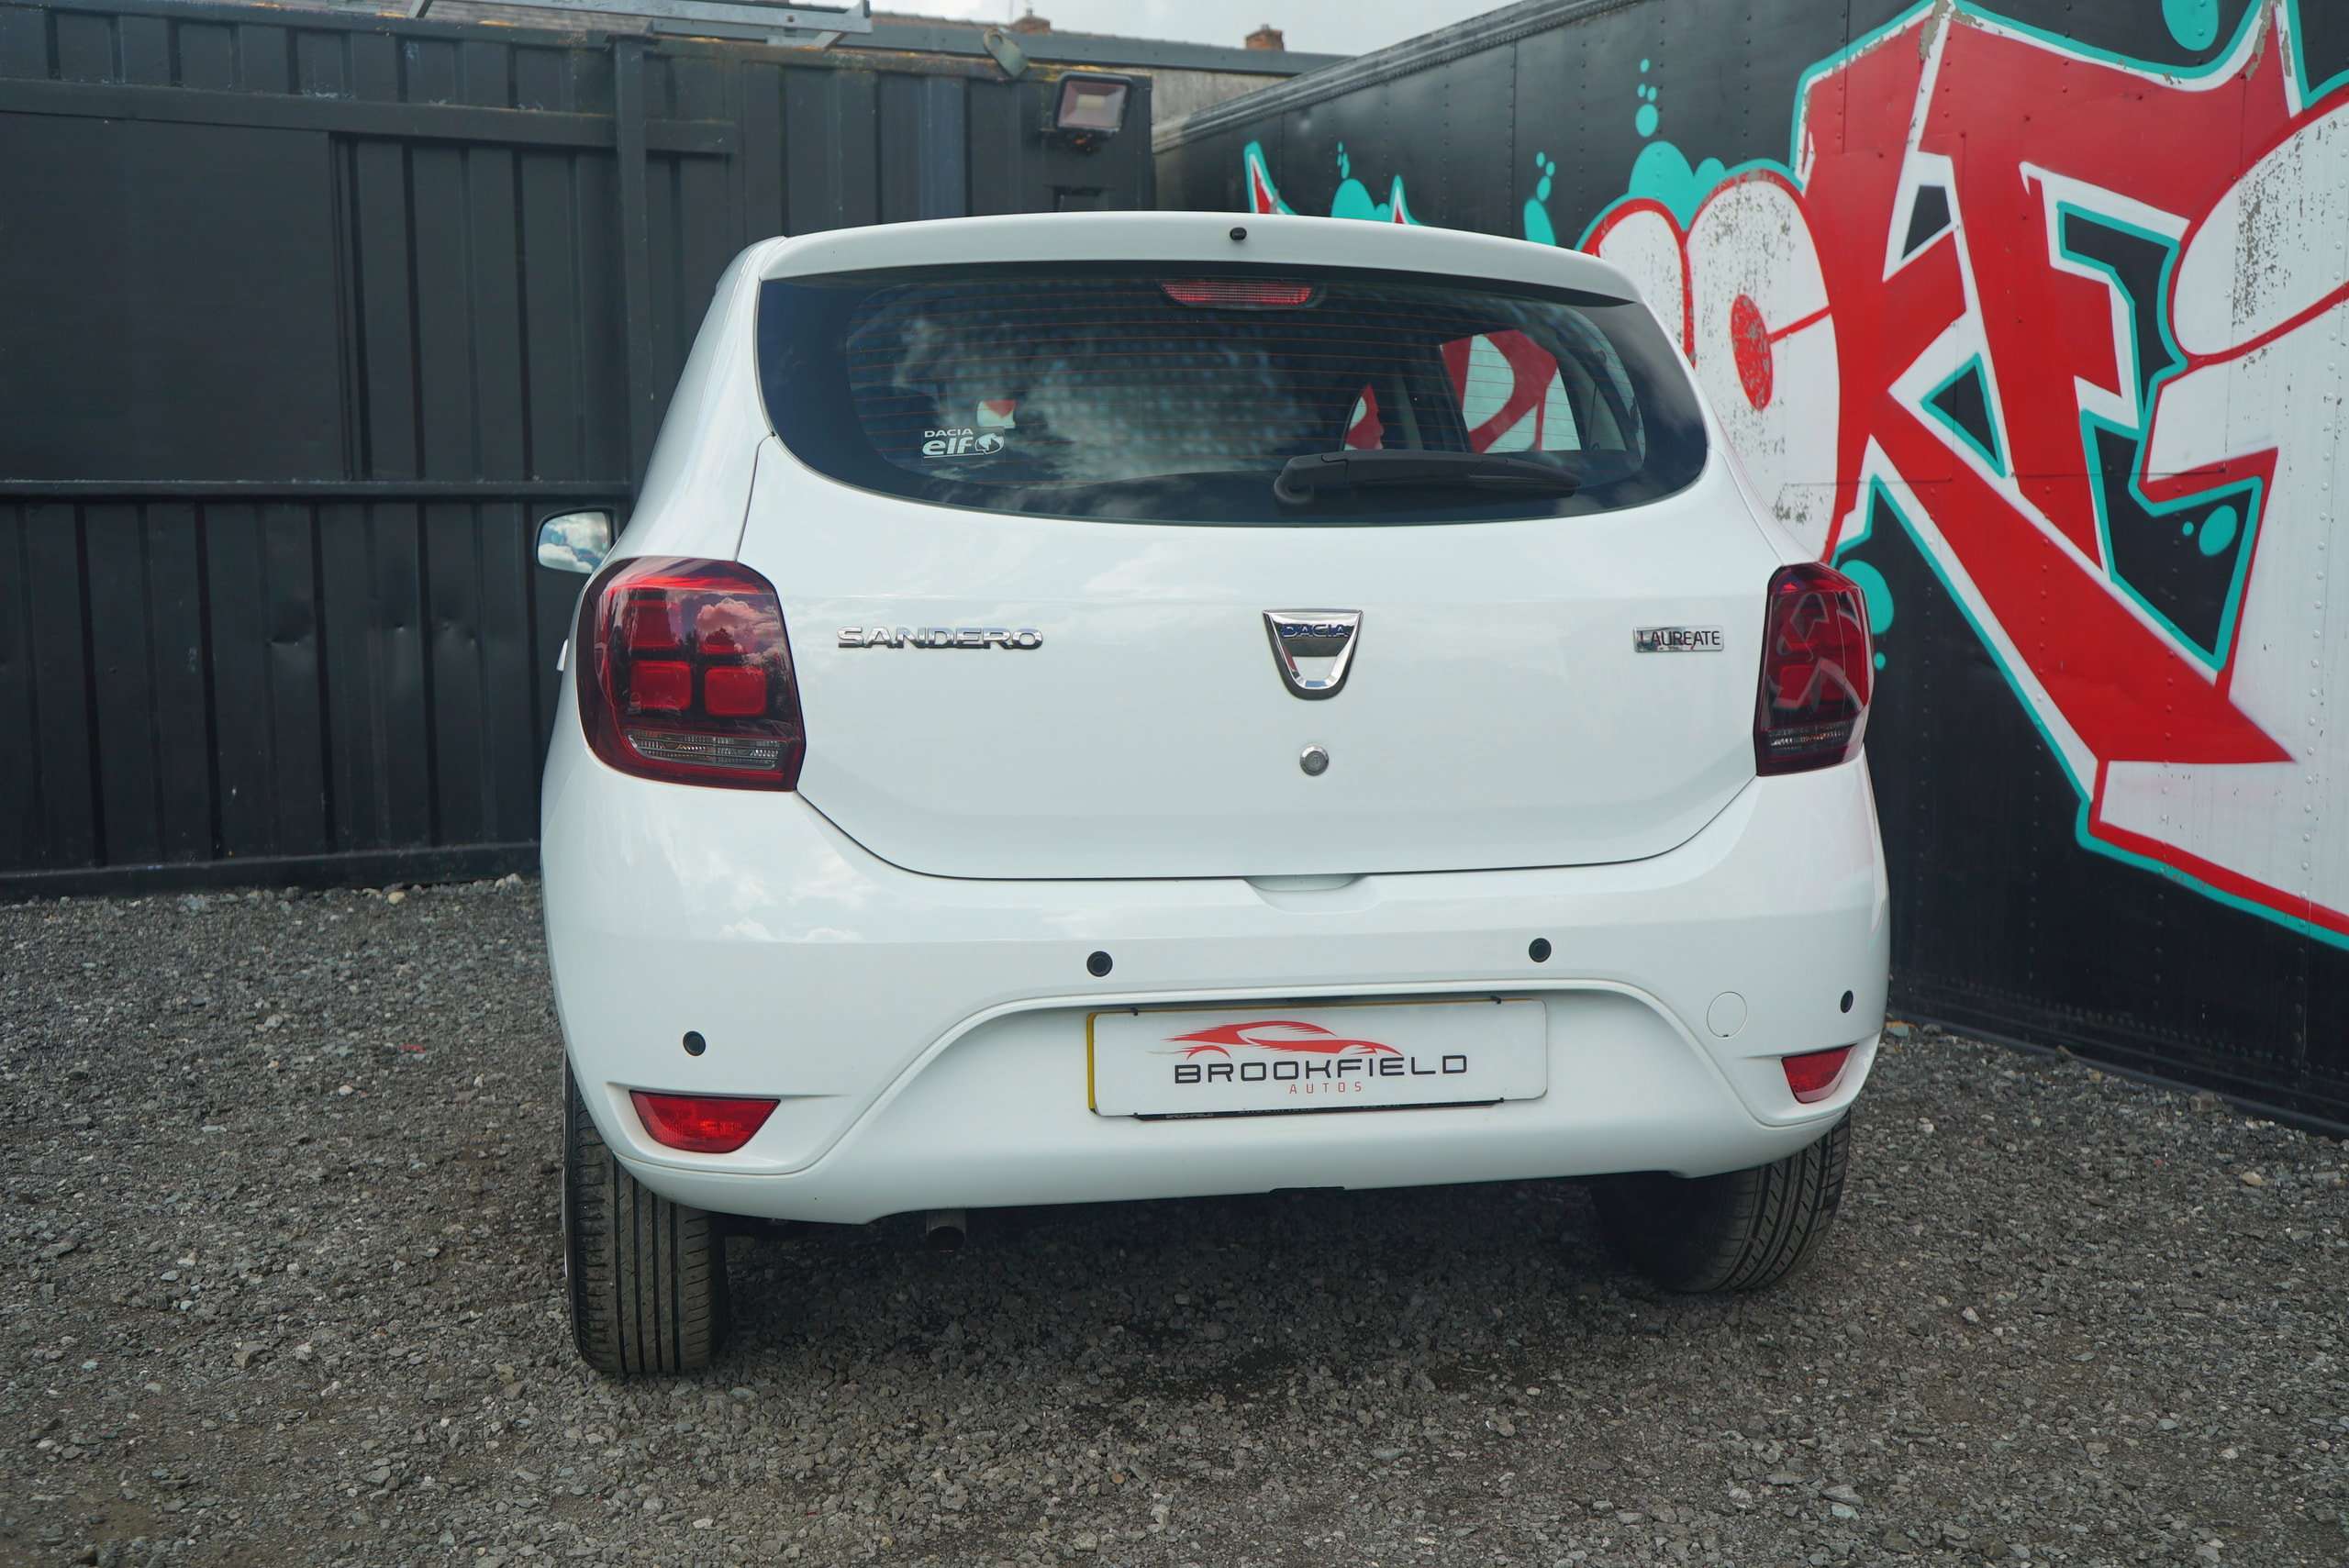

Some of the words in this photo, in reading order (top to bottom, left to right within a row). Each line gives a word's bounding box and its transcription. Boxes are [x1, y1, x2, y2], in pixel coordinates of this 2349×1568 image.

[924, 428, 974, 438] DACIA
[922, 437, 974, 456] elf
[837, 626, 1043, 650] SANDERO
[1282, 624, 1349, 638] DACIA
[1638, 630, 1721, 646] LAUREATE
[1174, 1055, 1467, 1084] BROOKFIELD
[1289, 1081, 1362, 1095] AUTOS
